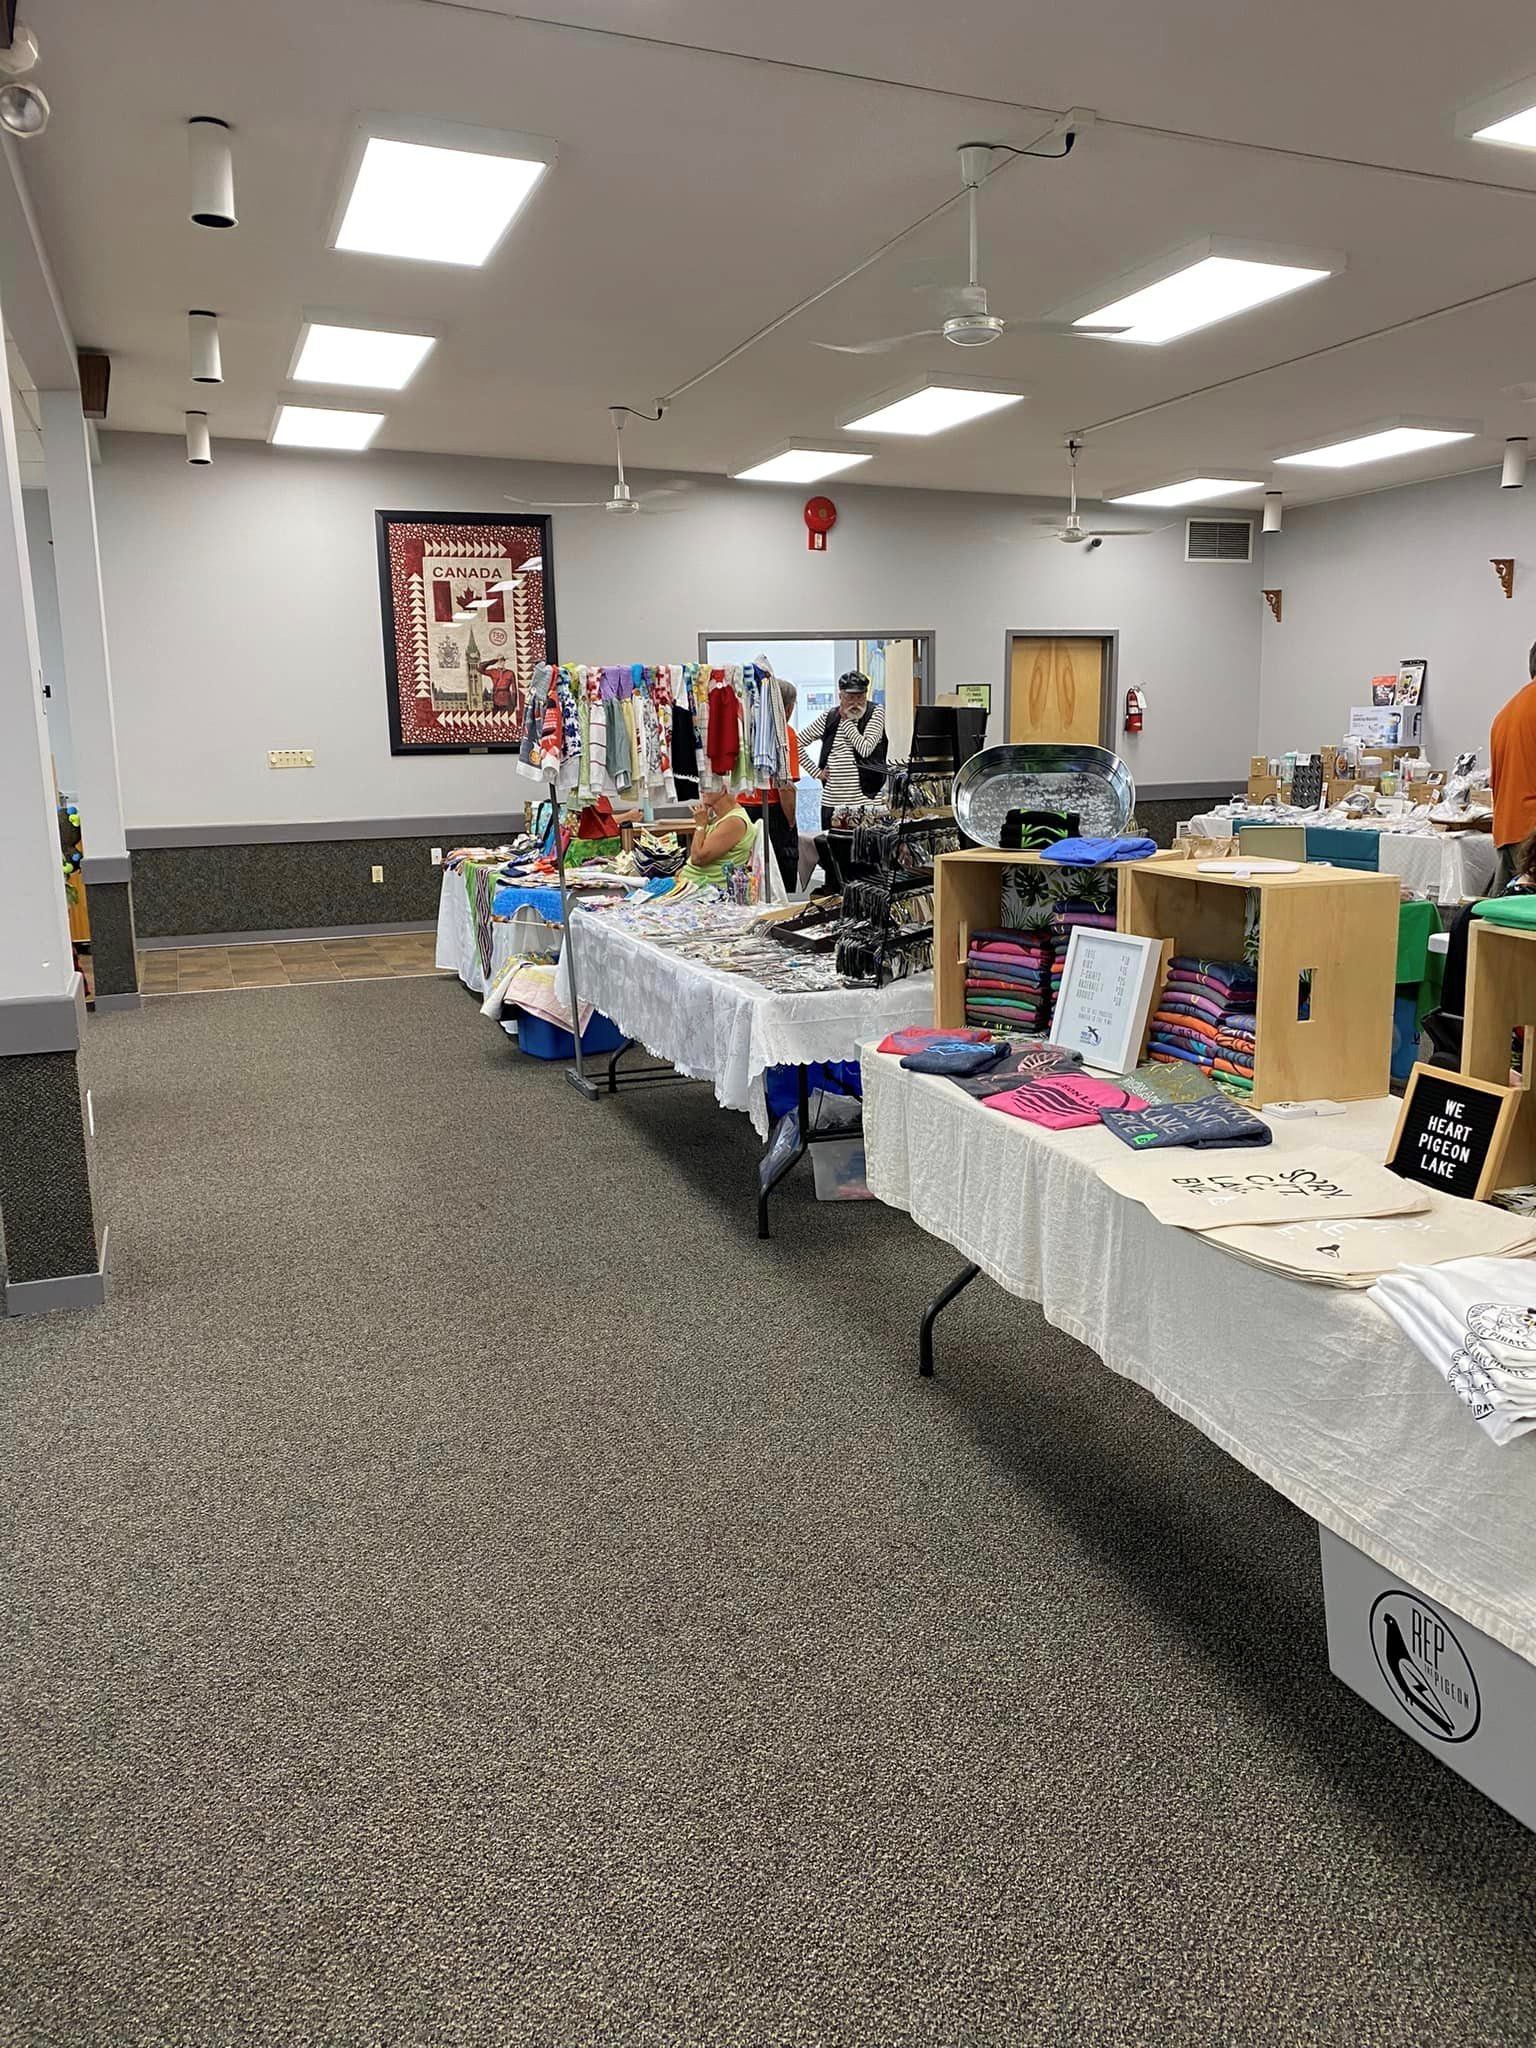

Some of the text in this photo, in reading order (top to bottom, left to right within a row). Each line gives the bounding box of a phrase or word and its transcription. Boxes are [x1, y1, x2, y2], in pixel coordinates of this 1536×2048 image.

[433, 566, 502, 579] CANADA
[1445, 1099, 1466, 1119] WE
[1427, 1115, 1473, 1143] HEART
[1418, 1133, 1471, 1164] PIGEON
[1420, 1154, 1457, 1179] LAKE
[1411, 1607, 1445, 1670] REP
[1434, 1671, 1469, 1710] PIGEON
